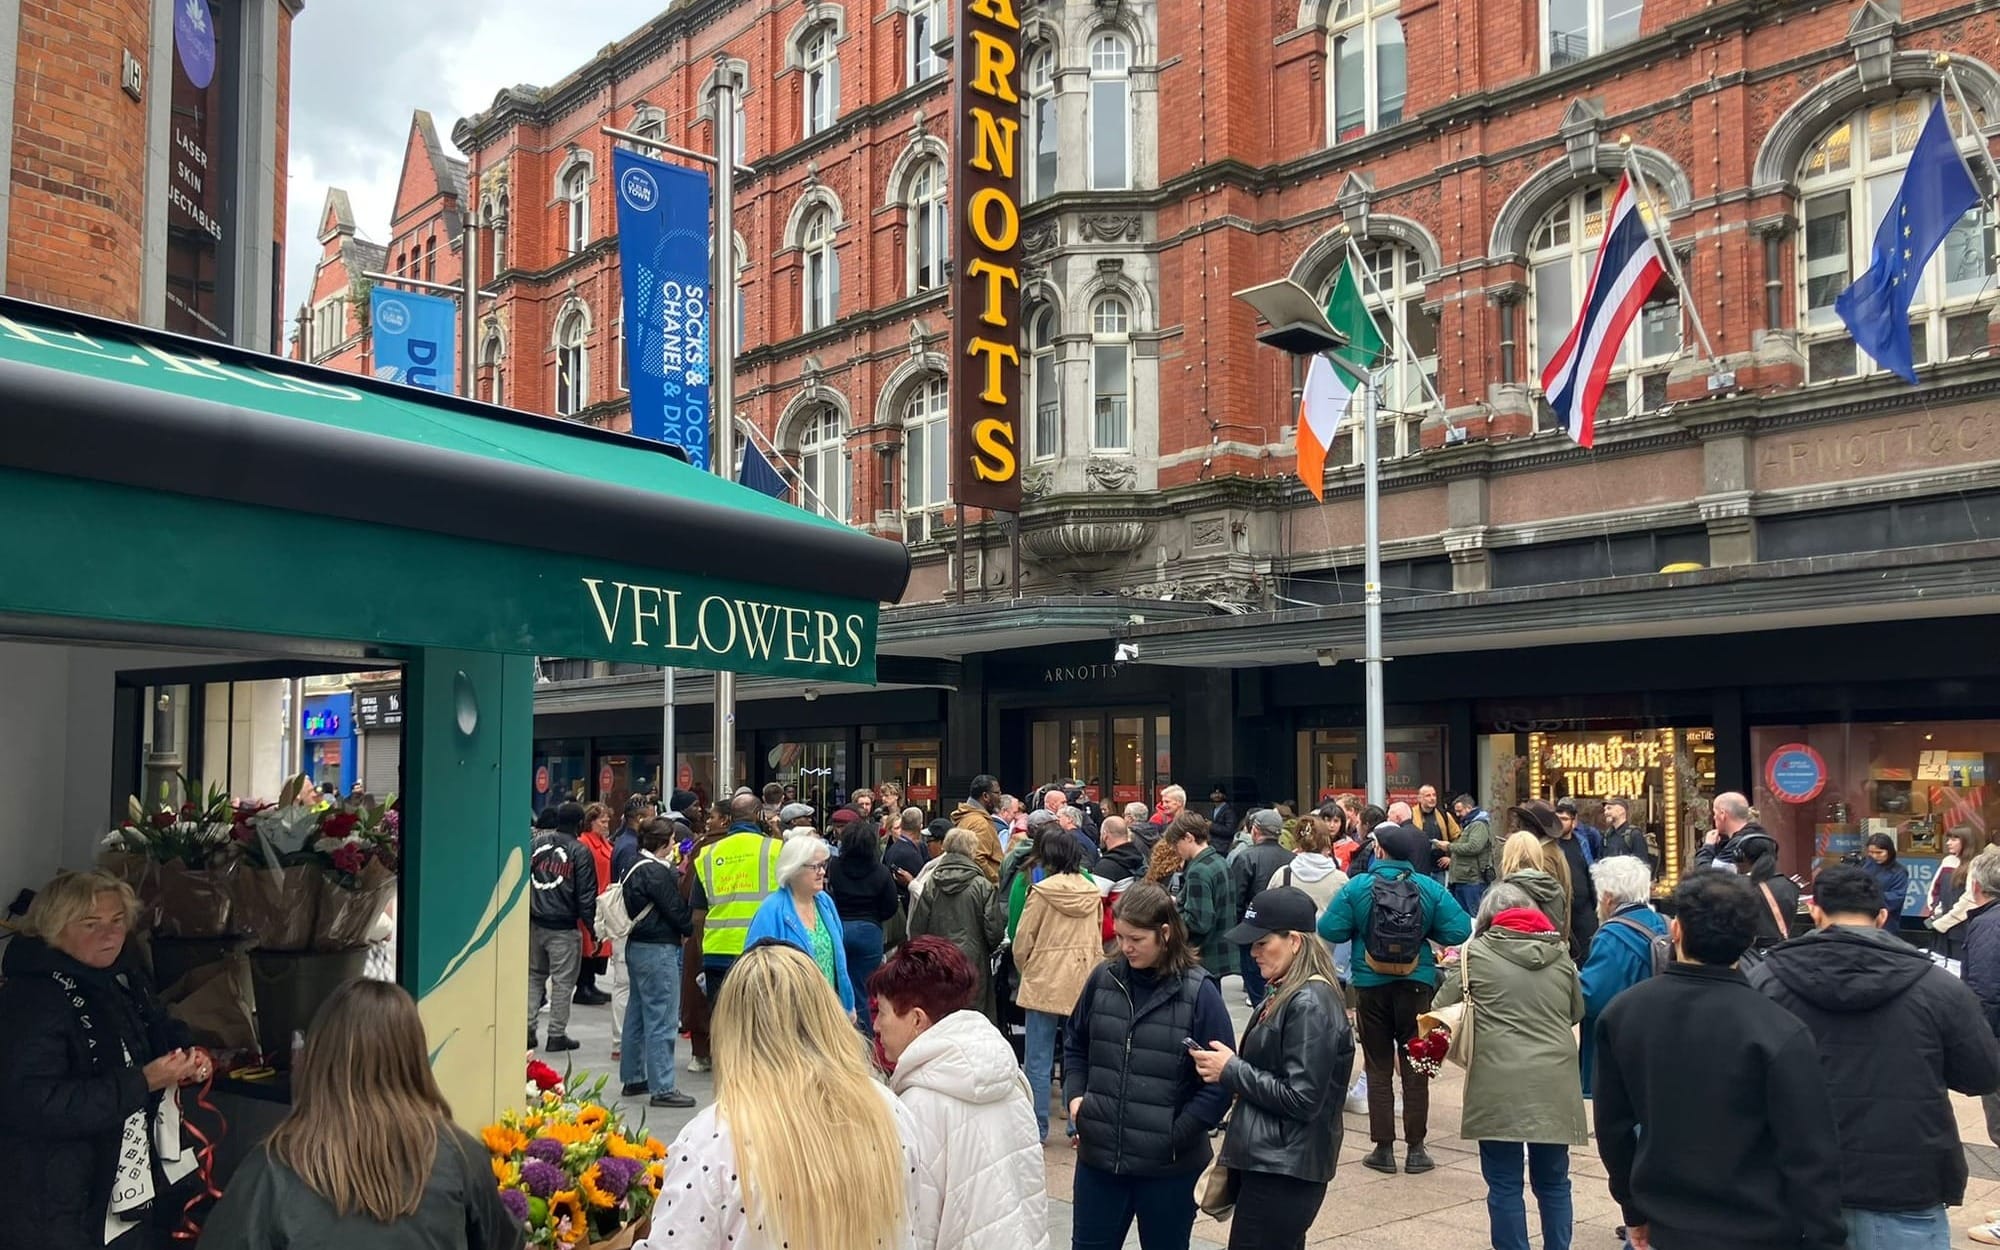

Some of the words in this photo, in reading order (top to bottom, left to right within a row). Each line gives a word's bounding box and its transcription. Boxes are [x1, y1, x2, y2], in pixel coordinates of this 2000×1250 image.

[176, 127, 208, 170] LASER
[177, 160, 202, 193] SKIN
[663, 281, 682, 375] CHANEL
[685, 284, 704, 365] SOCKS
[663, 381, 682, 398] &
[685, 370, 704, 387] &
[1759, 424, 1921, 481] ARNOTT
[582, 577, 864, 668] VFLOWERS
[1045, 663, 1118, 682] ARNOTTS
[1563, 770, 1646, 797] TILBURY
